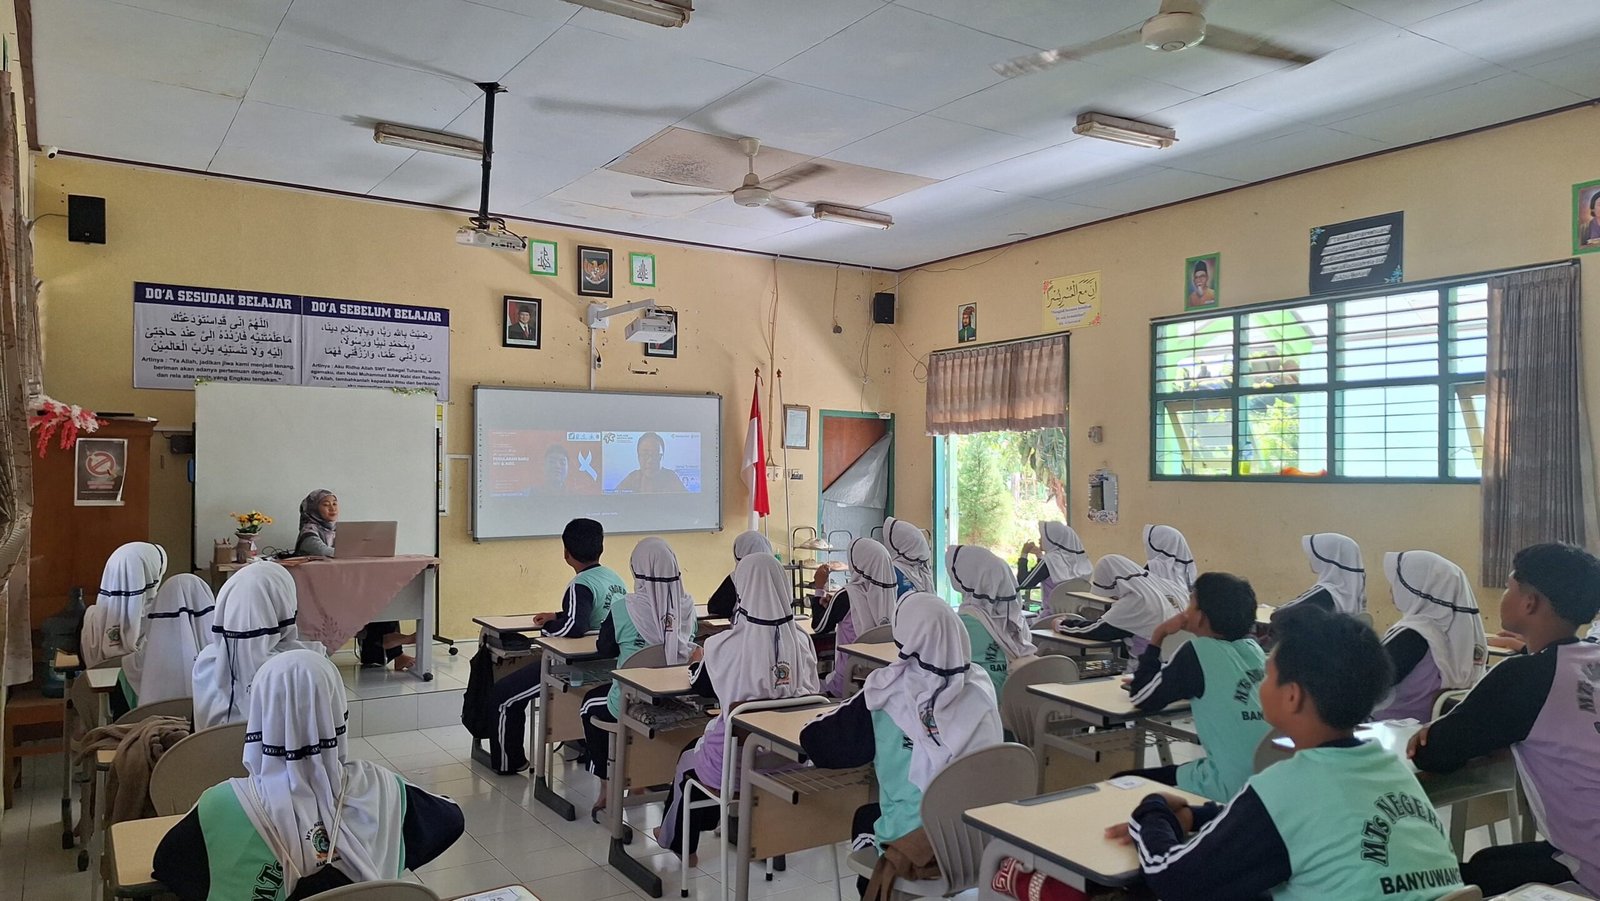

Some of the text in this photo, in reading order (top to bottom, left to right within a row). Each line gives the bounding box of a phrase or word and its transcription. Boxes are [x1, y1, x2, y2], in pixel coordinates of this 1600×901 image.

[145, 287, 293, 310] DO'A SESUDAH BELAJAR
[311, 301, 442, 322] DO'A SEBELUM BELAJAR
